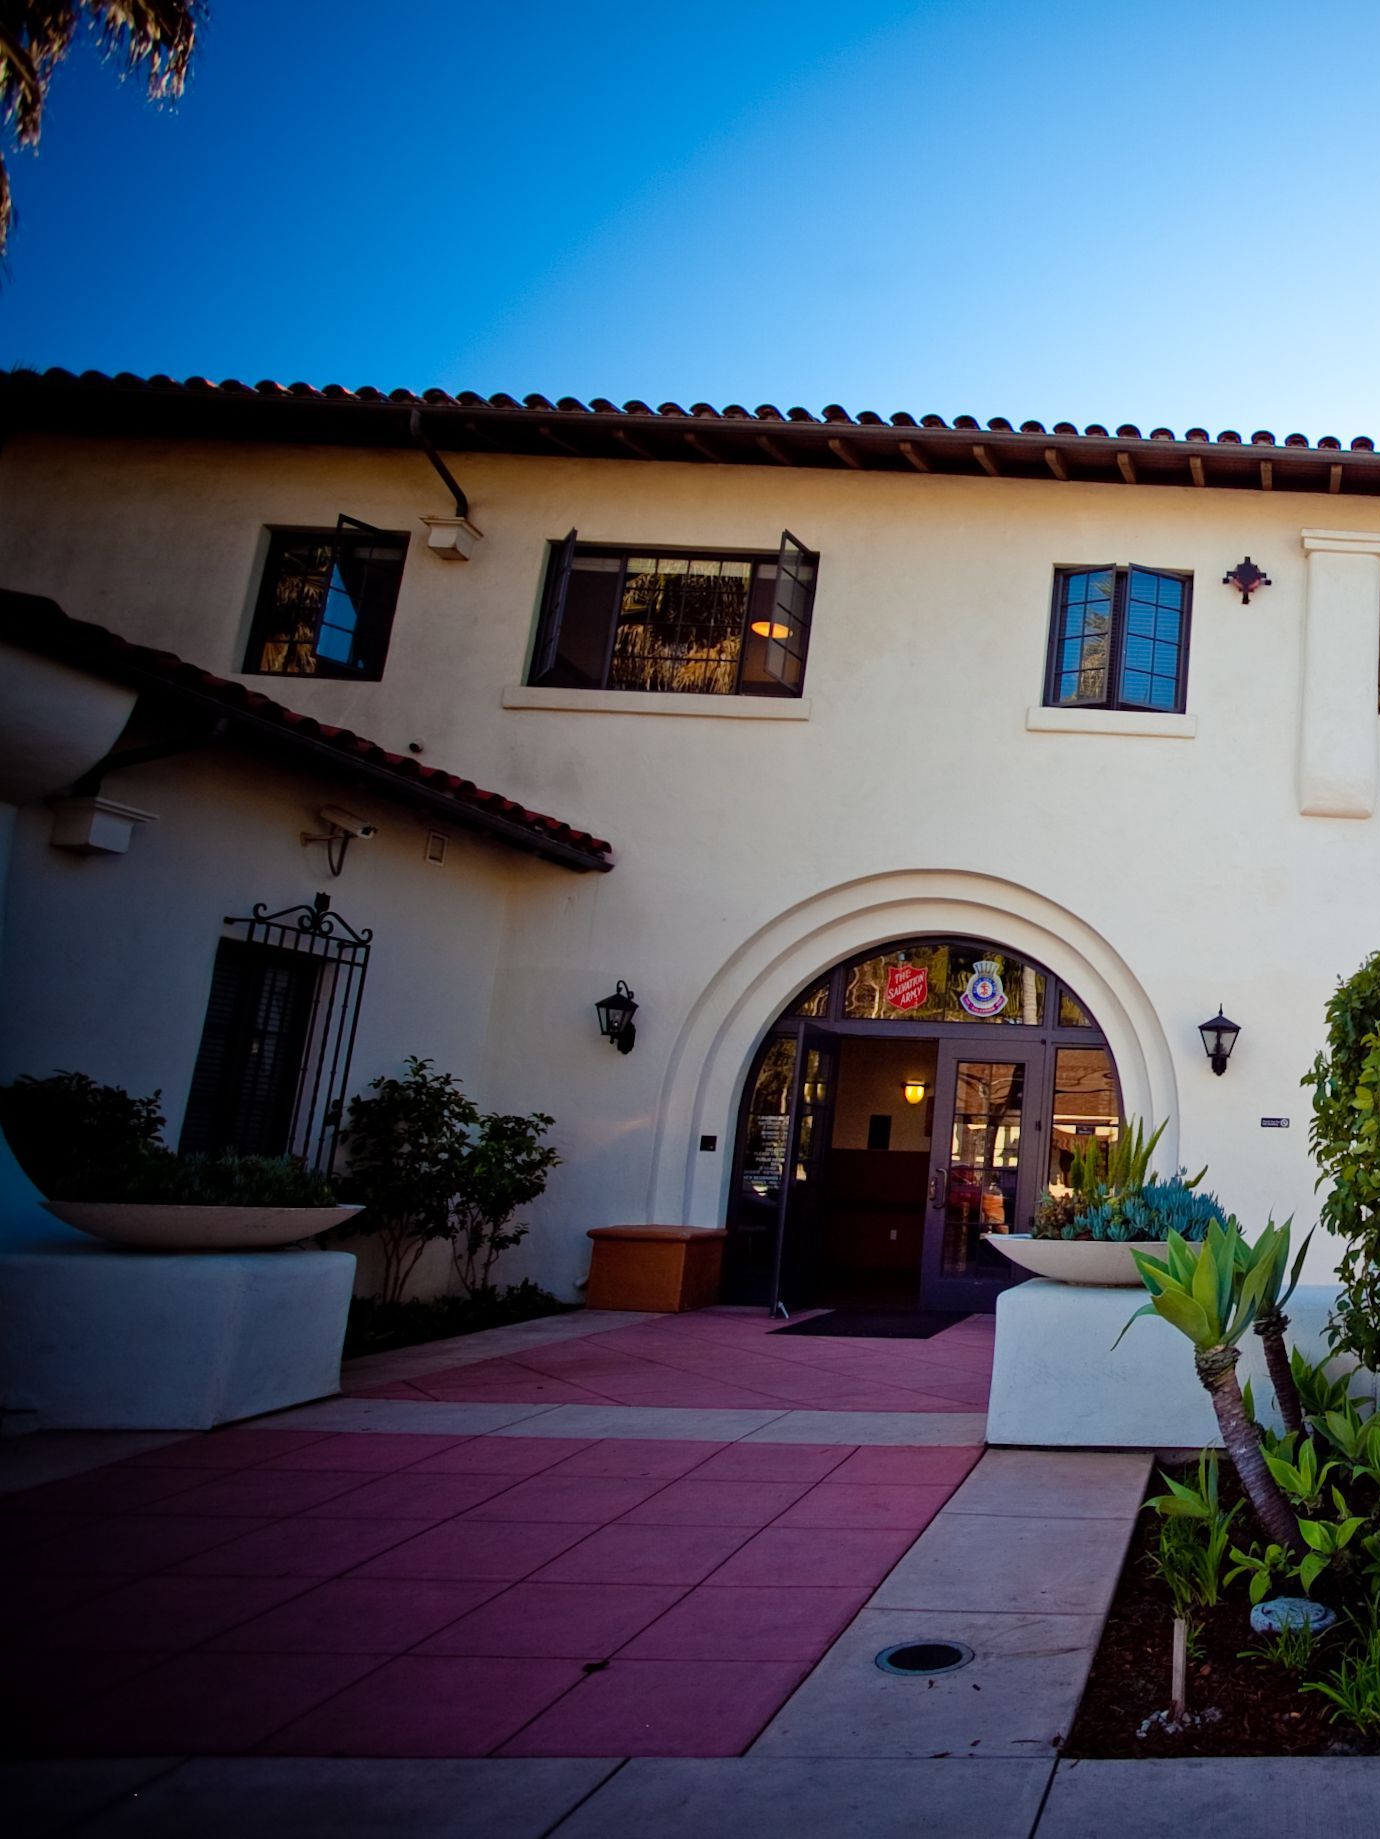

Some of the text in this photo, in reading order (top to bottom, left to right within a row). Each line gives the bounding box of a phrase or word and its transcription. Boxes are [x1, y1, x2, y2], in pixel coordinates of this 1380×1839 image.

[888, 971, 925, 1000] SALVATION
[895, 969, 911, 984] THE
[900, 984, 922, 1006] ARMY
